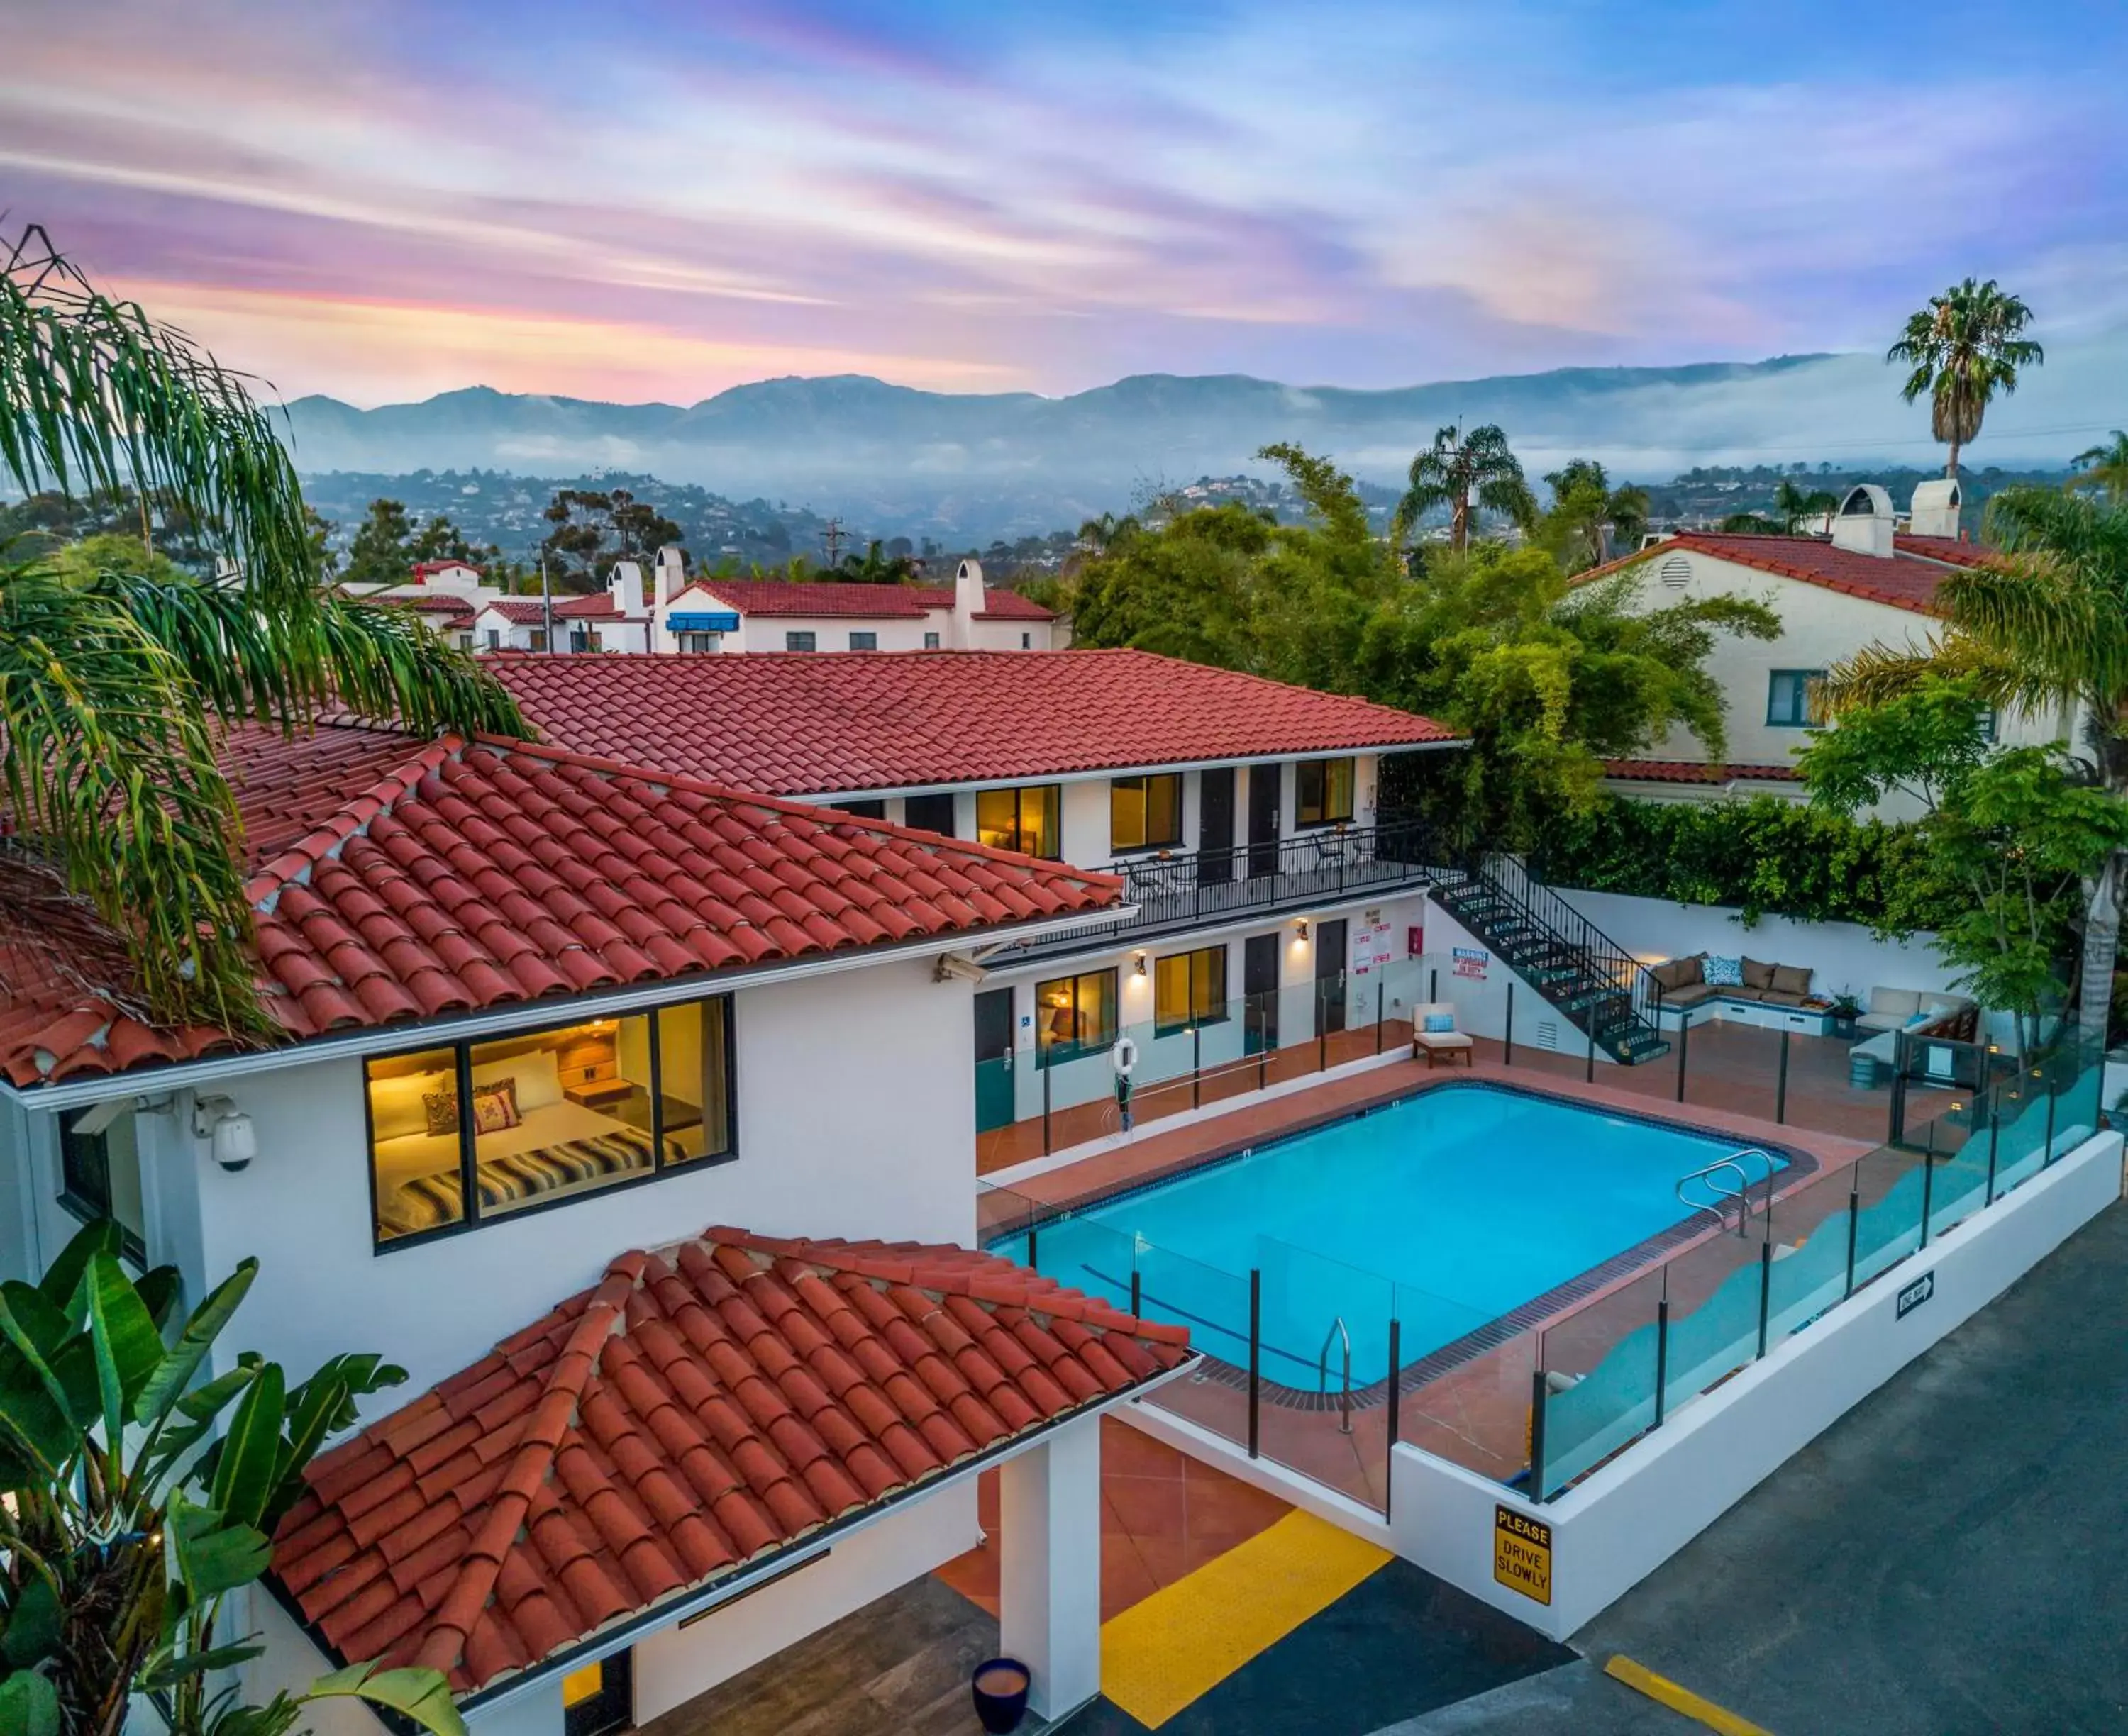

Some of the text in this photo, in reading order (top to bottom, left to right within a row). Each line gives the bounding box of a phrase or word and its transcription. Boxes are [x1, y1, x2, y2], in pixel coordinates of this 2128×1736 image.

[1499, 1511, 1548, 1545] PLEASE
[1504, 1540, 1542, 1569] DRIVE
[1498, 1556, 1546, 1589] SLOWLY
